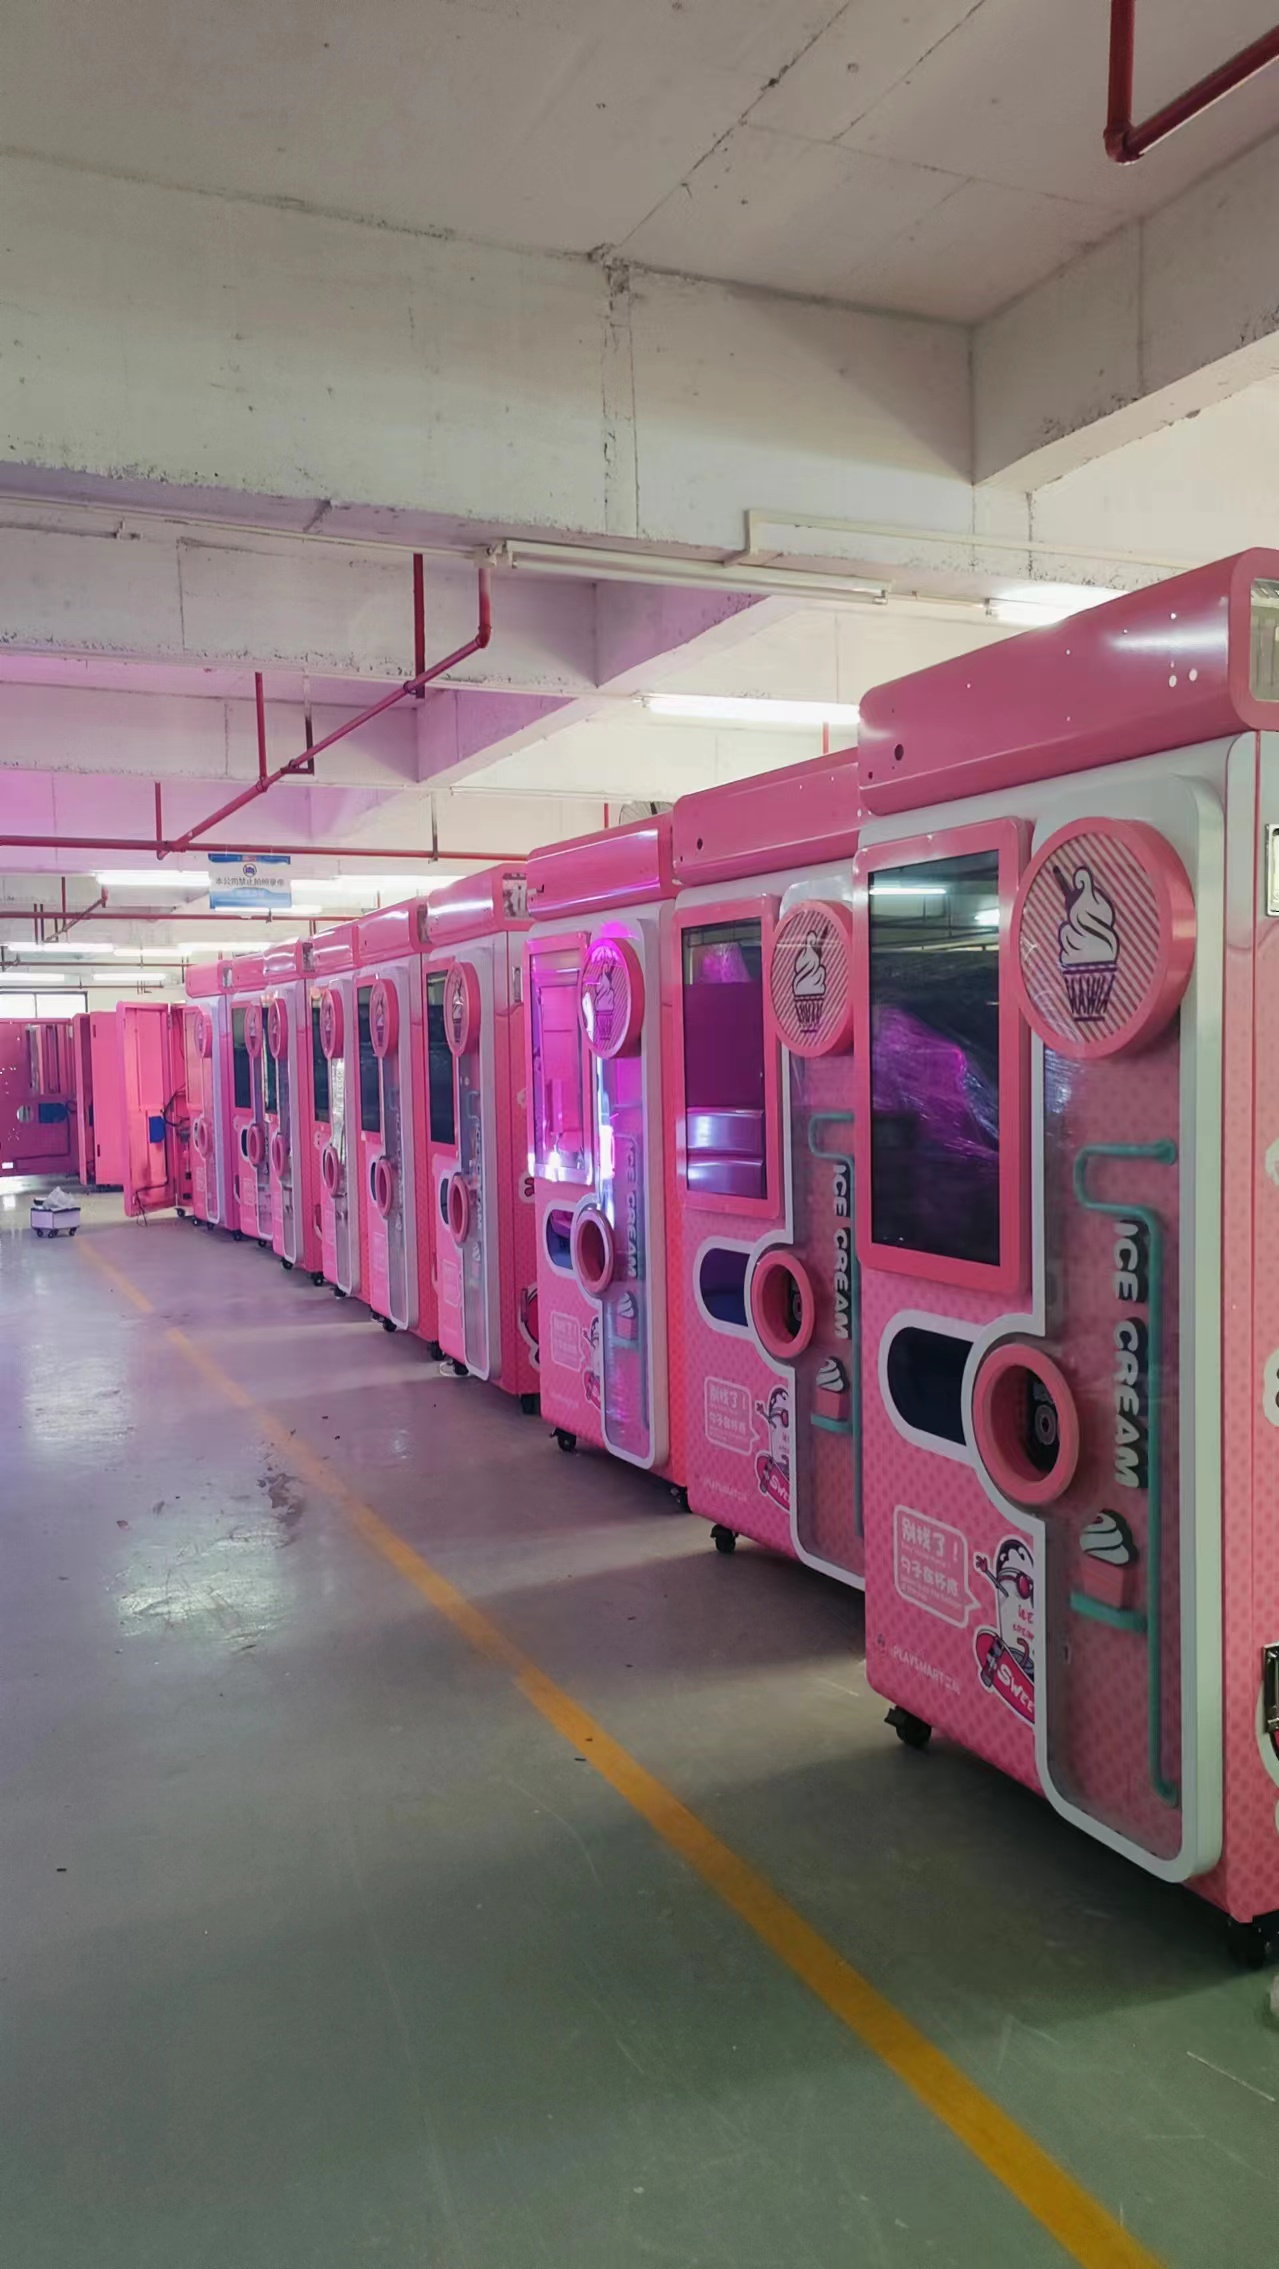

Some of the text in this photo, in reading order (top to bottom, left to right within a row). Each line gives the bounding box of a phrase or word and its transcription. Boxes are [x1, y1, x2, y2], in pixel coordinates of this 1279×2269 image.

[626, 1190, 638, 1278] CREAM
[832, 1164, 850, 1340] ICE CREAM
[1112, 1221, 1143, 1488] ICE CREAM
